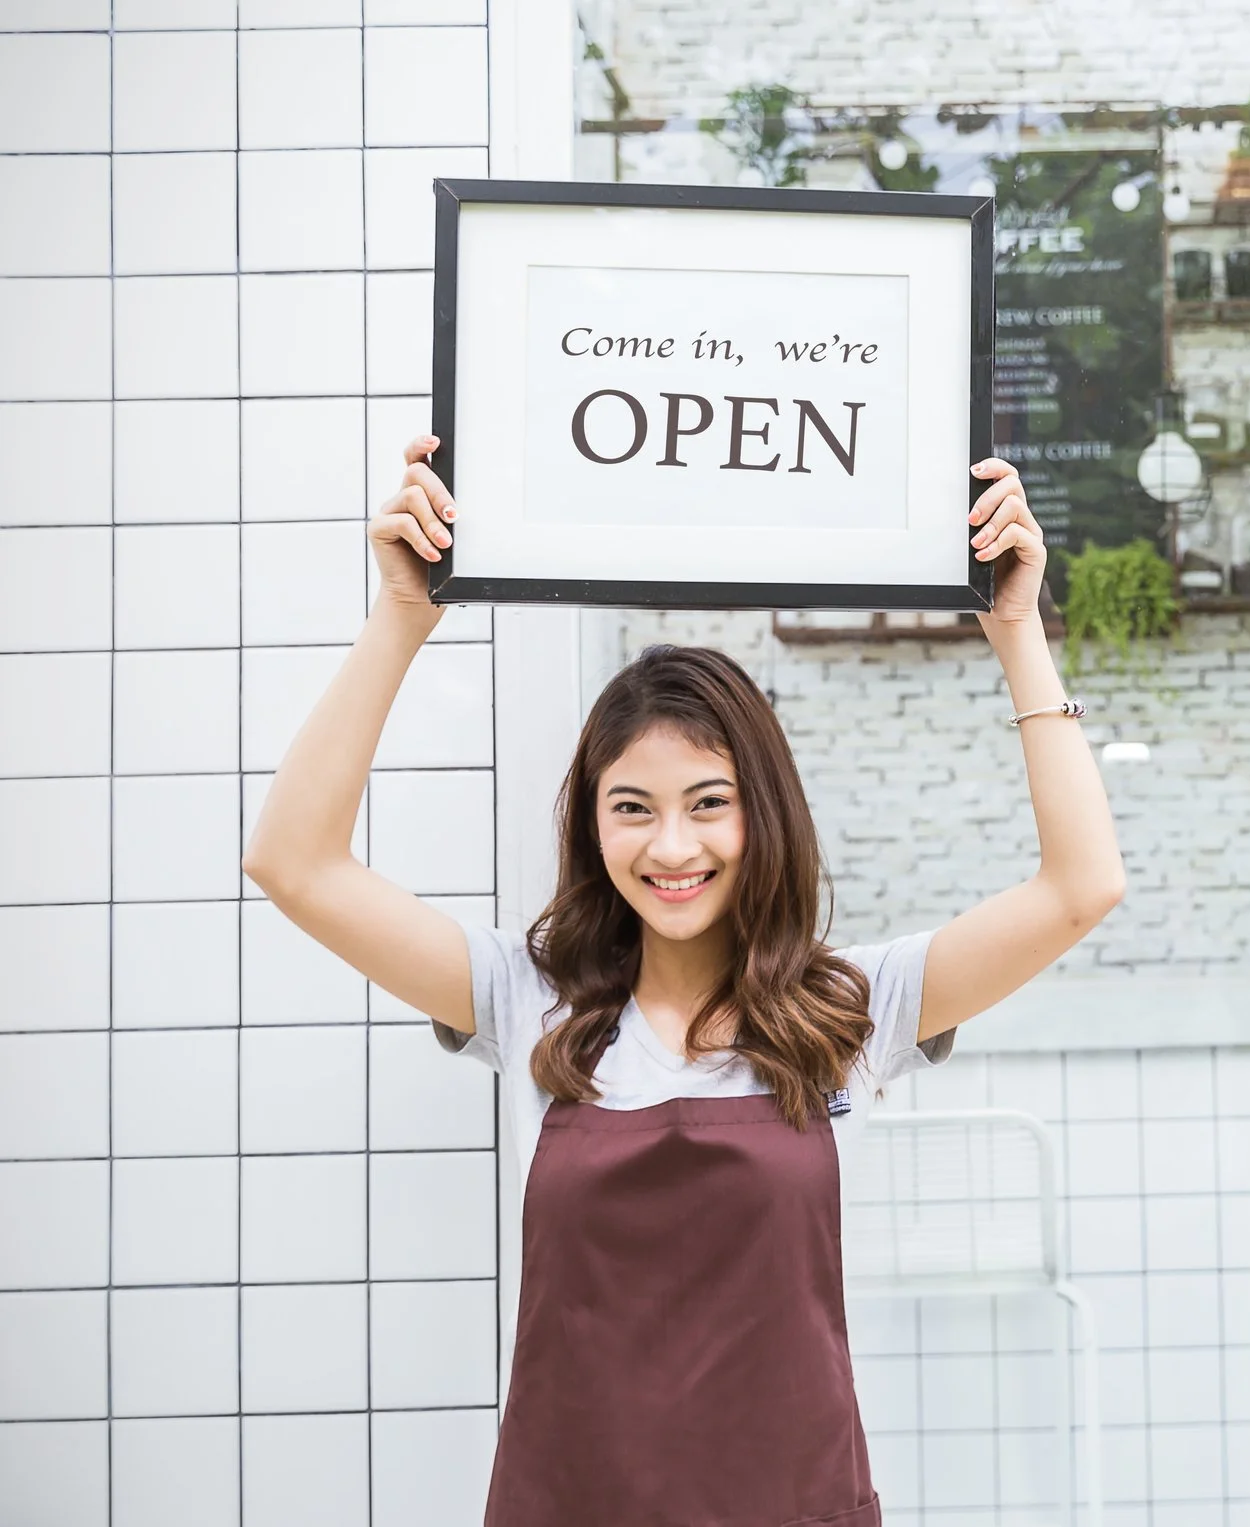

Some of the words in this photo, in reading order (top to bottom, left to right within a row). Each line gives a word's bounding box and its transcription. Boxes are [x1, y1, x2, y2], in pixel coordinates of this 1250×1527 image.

[560, 327, 676, 358] Come
[691, 330, 745, 367] in,
[774, 333, 879, 365] we're
[570, 388, 867, 477] OPEN
